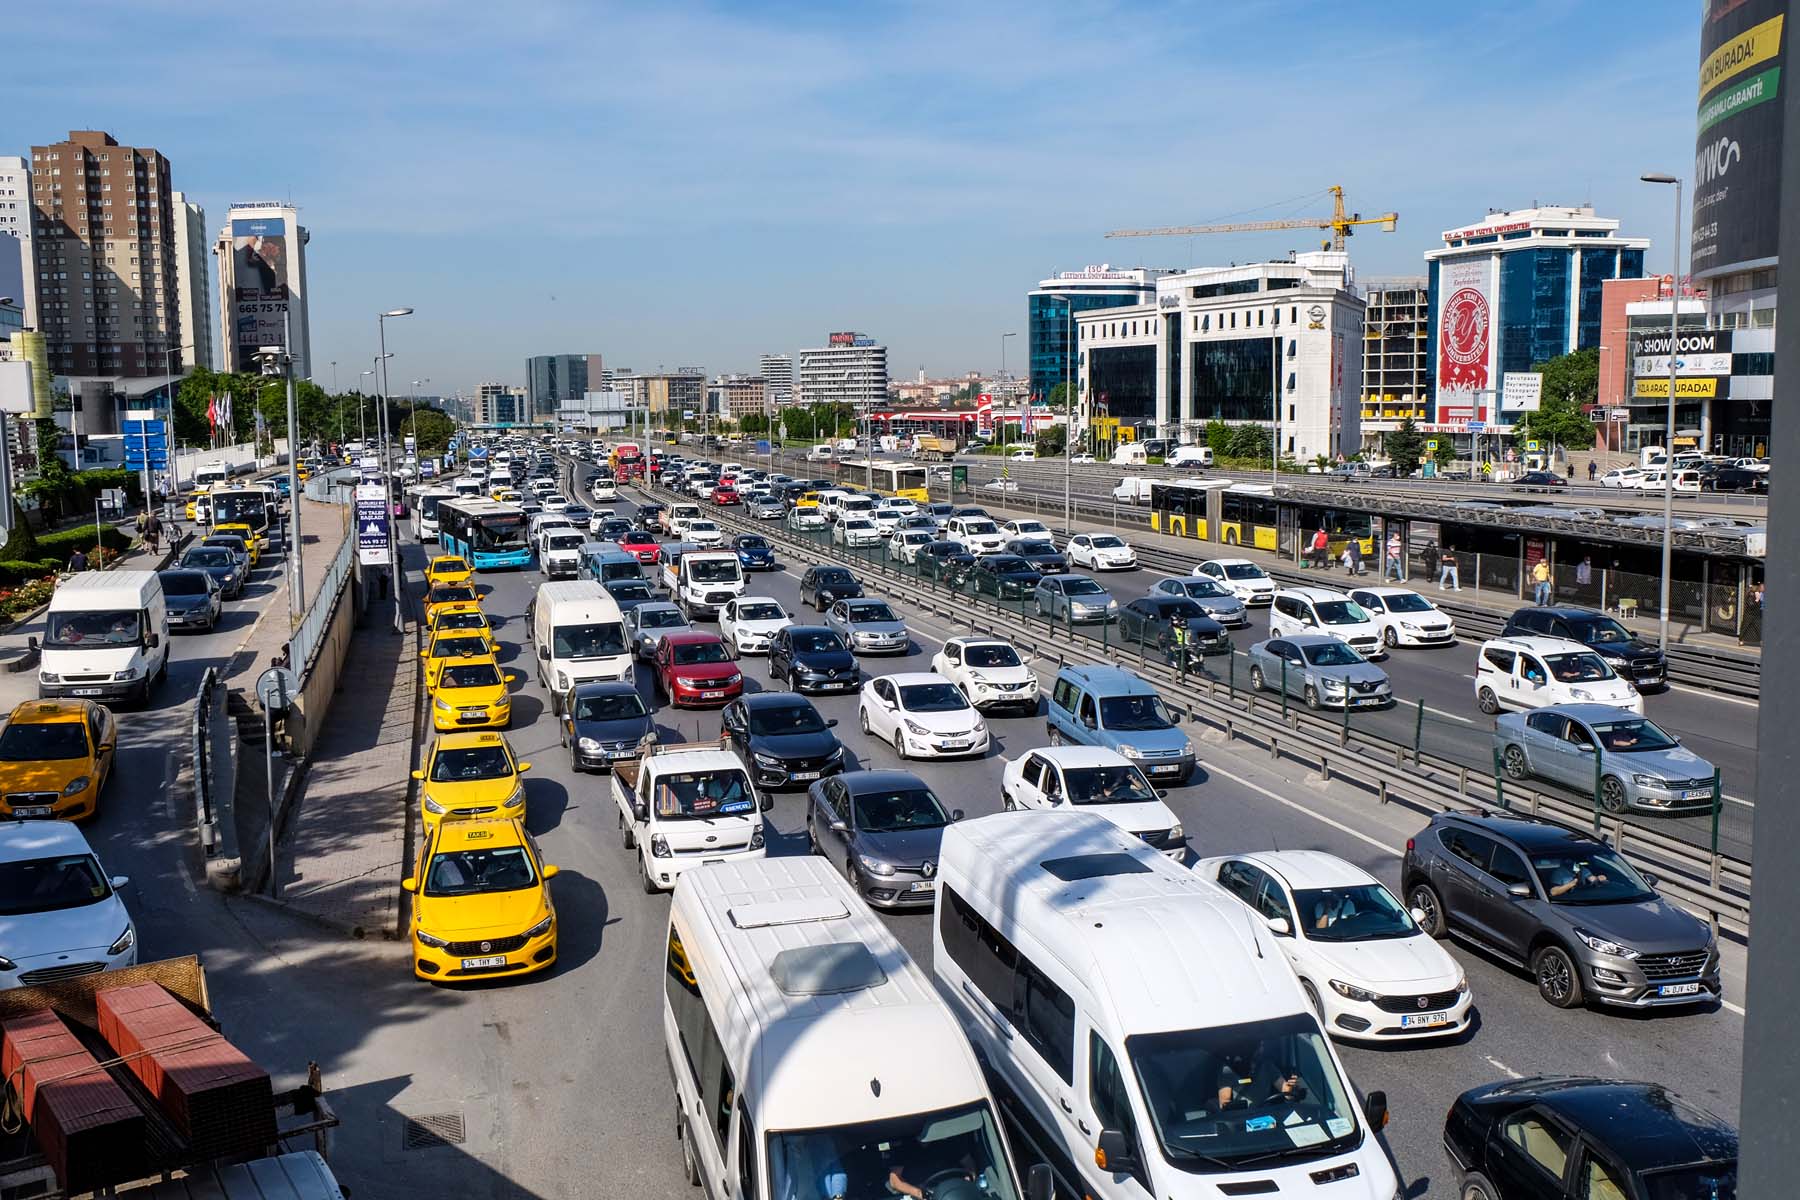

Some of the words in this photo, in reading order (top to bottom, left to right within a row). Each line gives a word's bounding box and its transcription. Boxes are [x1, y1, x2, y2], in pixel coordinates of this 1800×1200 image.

[1715, 37, 1755, 78] BURADA!
[239, 303, 258, 313] 665
[260, 303, 273, 313] 75
[275, 303, 288, 312] 75
[1675, 383, 1711, 393] URADA!
[466, 959, 475, 968] 34
[1407, 1016, 1415, 1026] 34
[1417, 1014, 1430, 1025] BNY
[1432, 1013, 1444, 1024] 976
